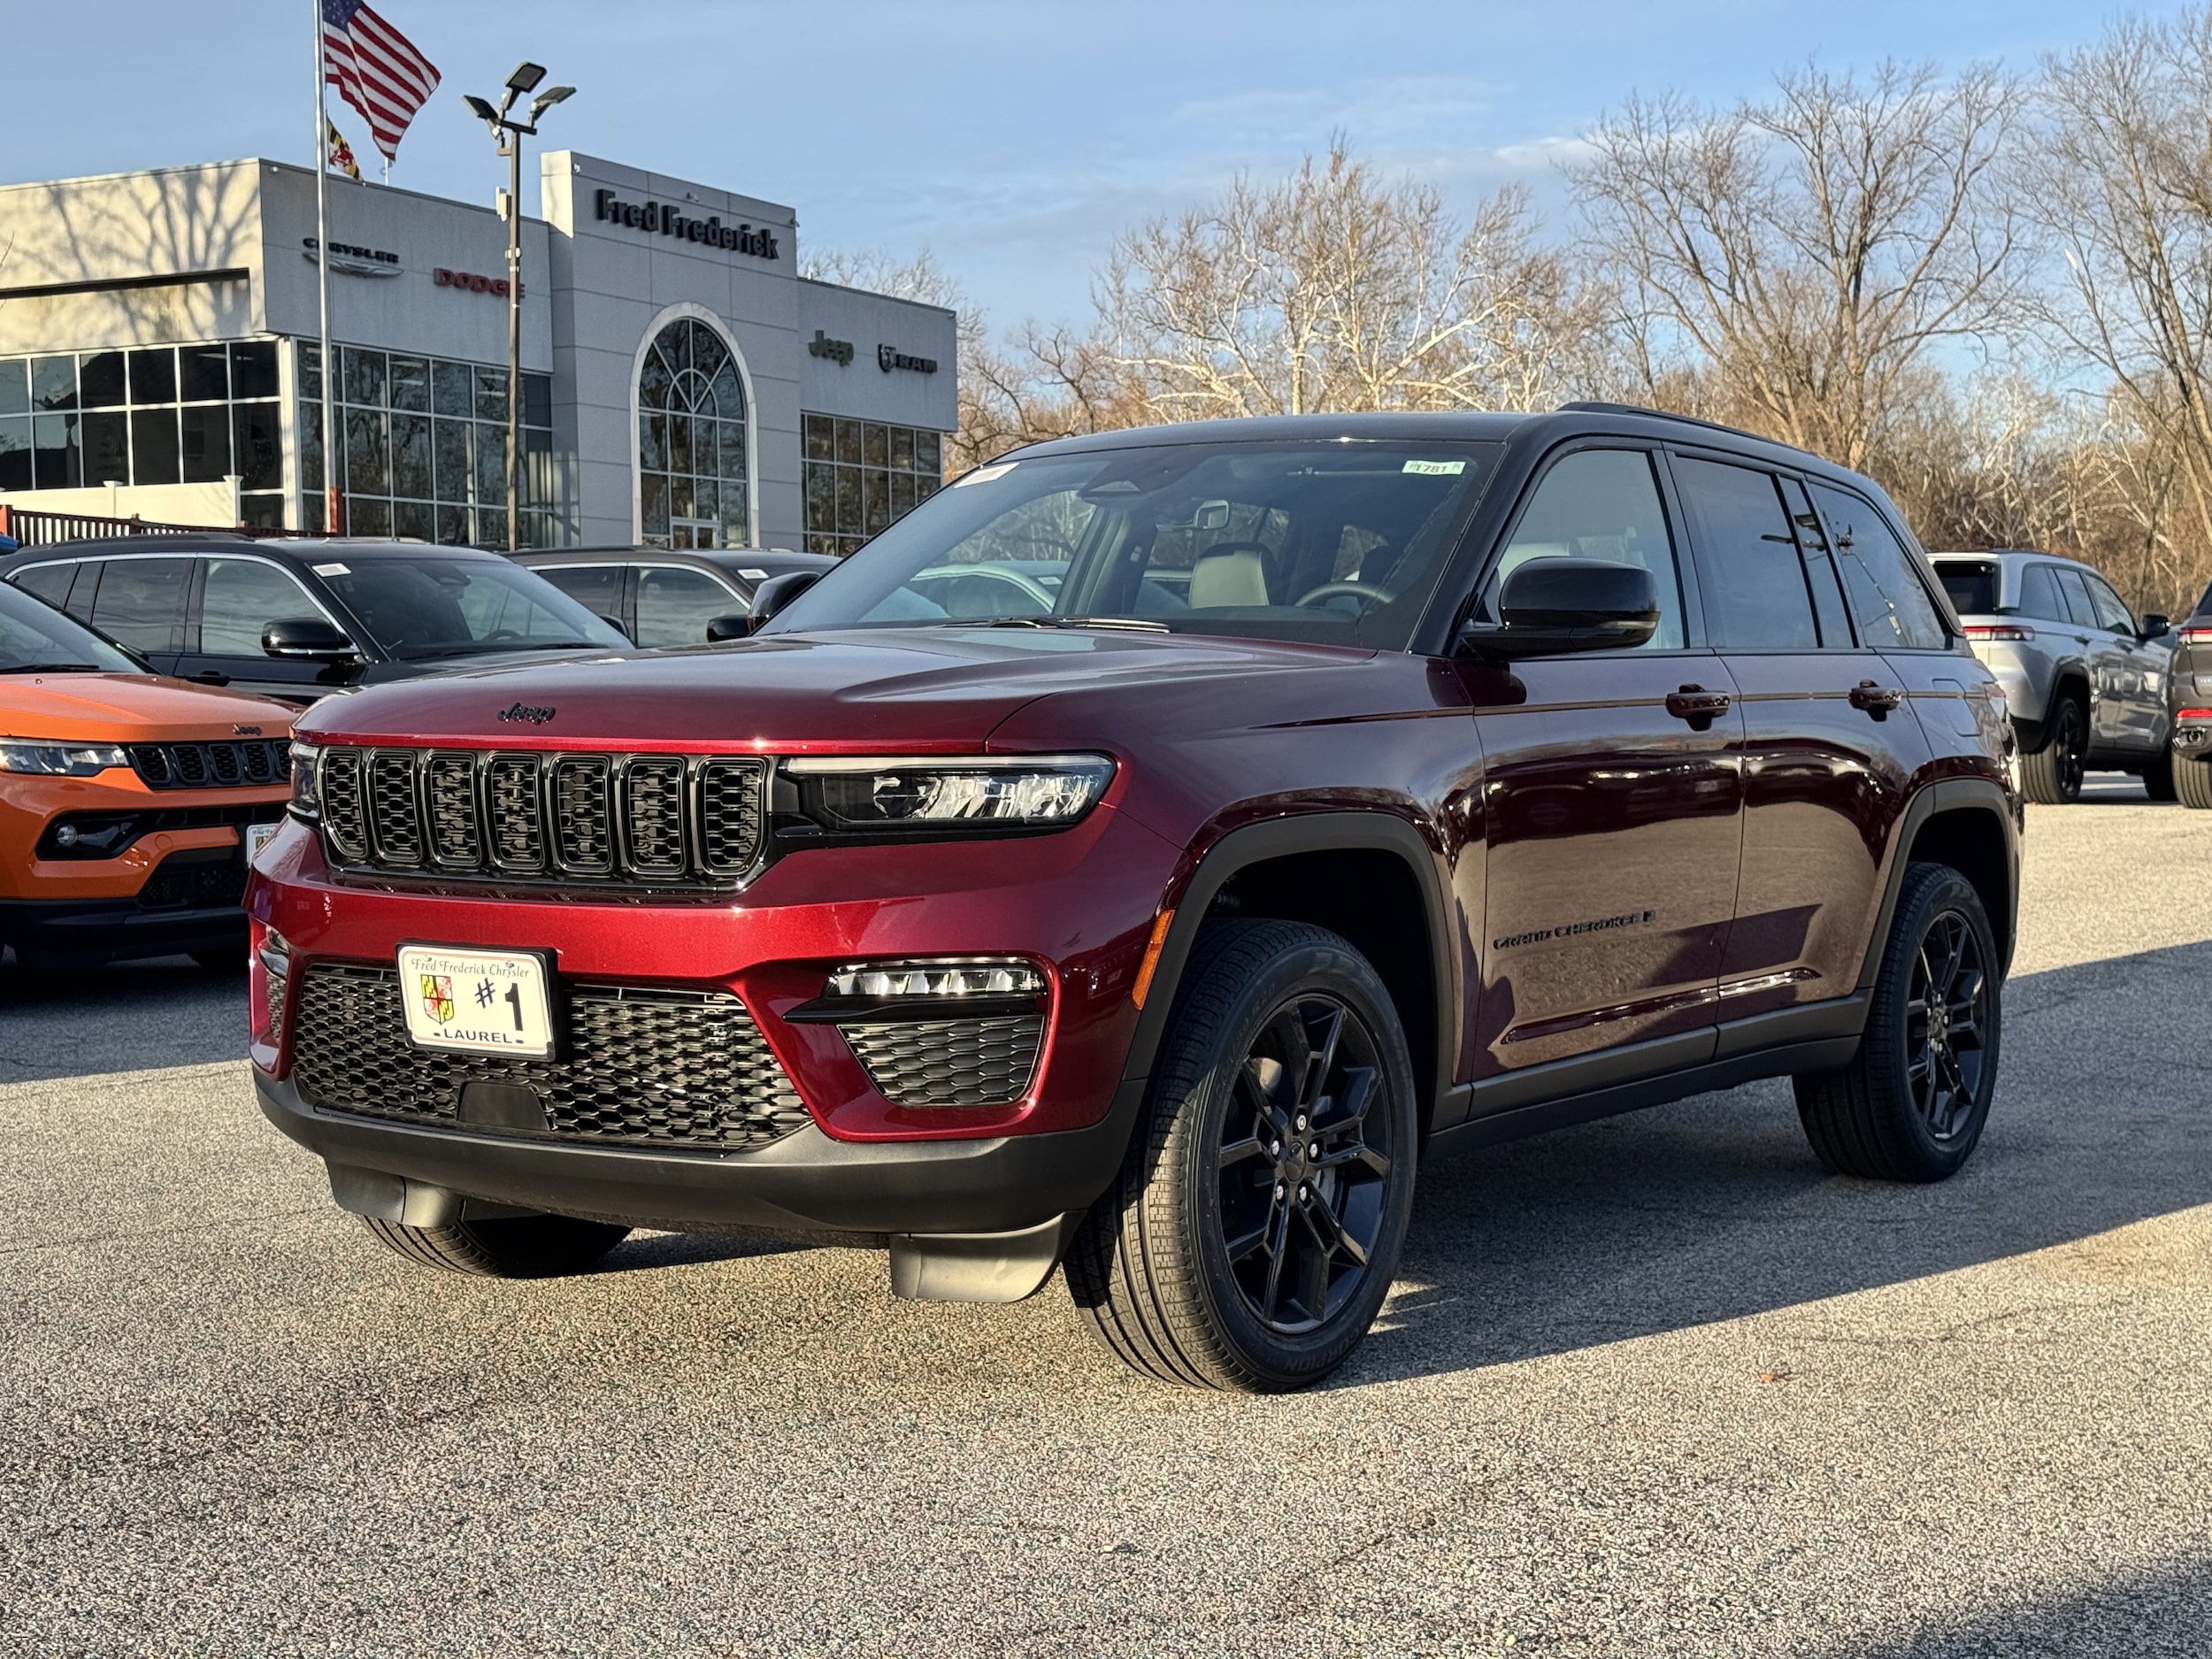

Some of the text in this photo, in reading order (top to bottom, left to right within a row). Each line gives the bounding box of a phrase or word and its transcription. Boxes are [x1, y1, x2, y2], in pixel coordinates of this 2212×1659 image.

[596, 188, 779, 259] Fred Frederick
[303, 237, 400, 264] CRYSLER
[808, 330, 854, 367] Jeep
[896, 354, 938, 373] RAM
[497, 703, 557, 726] Jeep
[411, 957, 530, 979] Fred Frederick Chrysler
